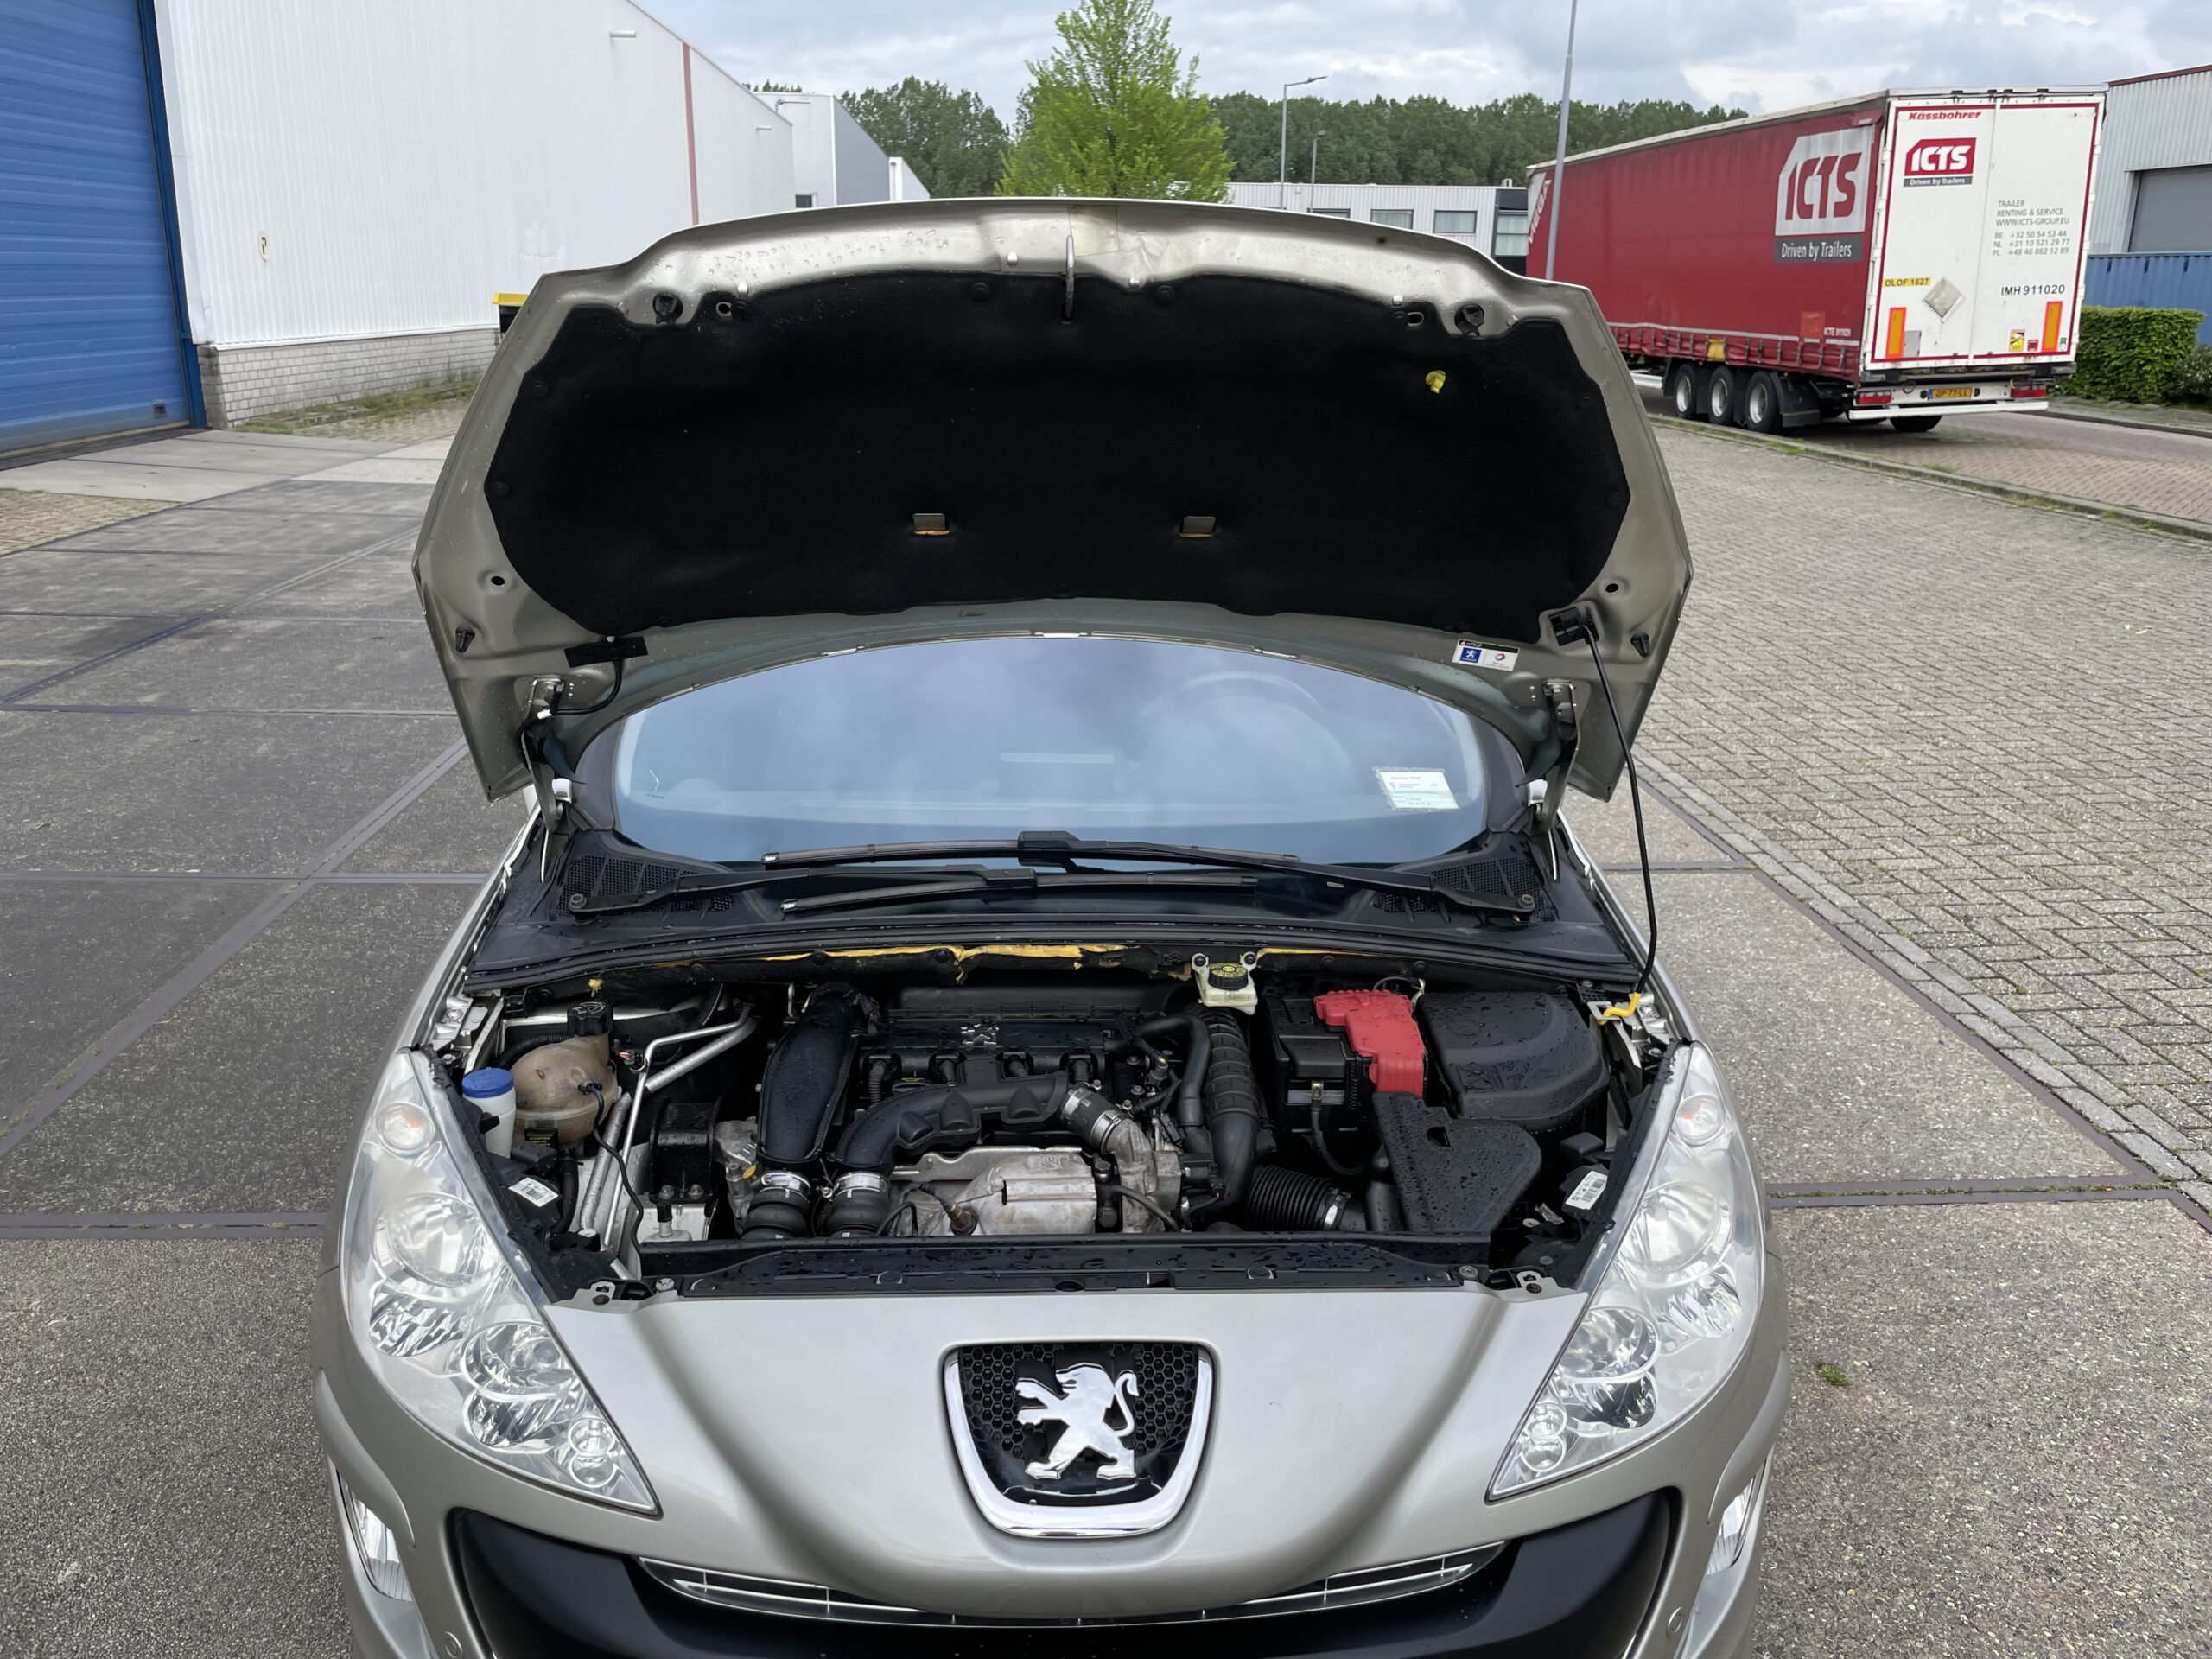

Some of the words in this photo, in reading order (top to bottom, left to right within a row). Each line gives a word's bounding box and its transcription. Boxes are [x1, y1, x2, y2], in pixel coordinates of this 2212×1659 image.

[1908, 111, 1981, 120] Kässbohrer
[1910, 145, 1971, 171] ICTS
[1785, 152, 1862, 220] ICTS
[1781, 243, 1807, 257] Driven
[1808, 242, 1820, 262] by
[1821, 241, 1852, 257] Trailers
[1885, 278, 1908, 287] OLOF
[1911, 277, 1929, 286] 1627
